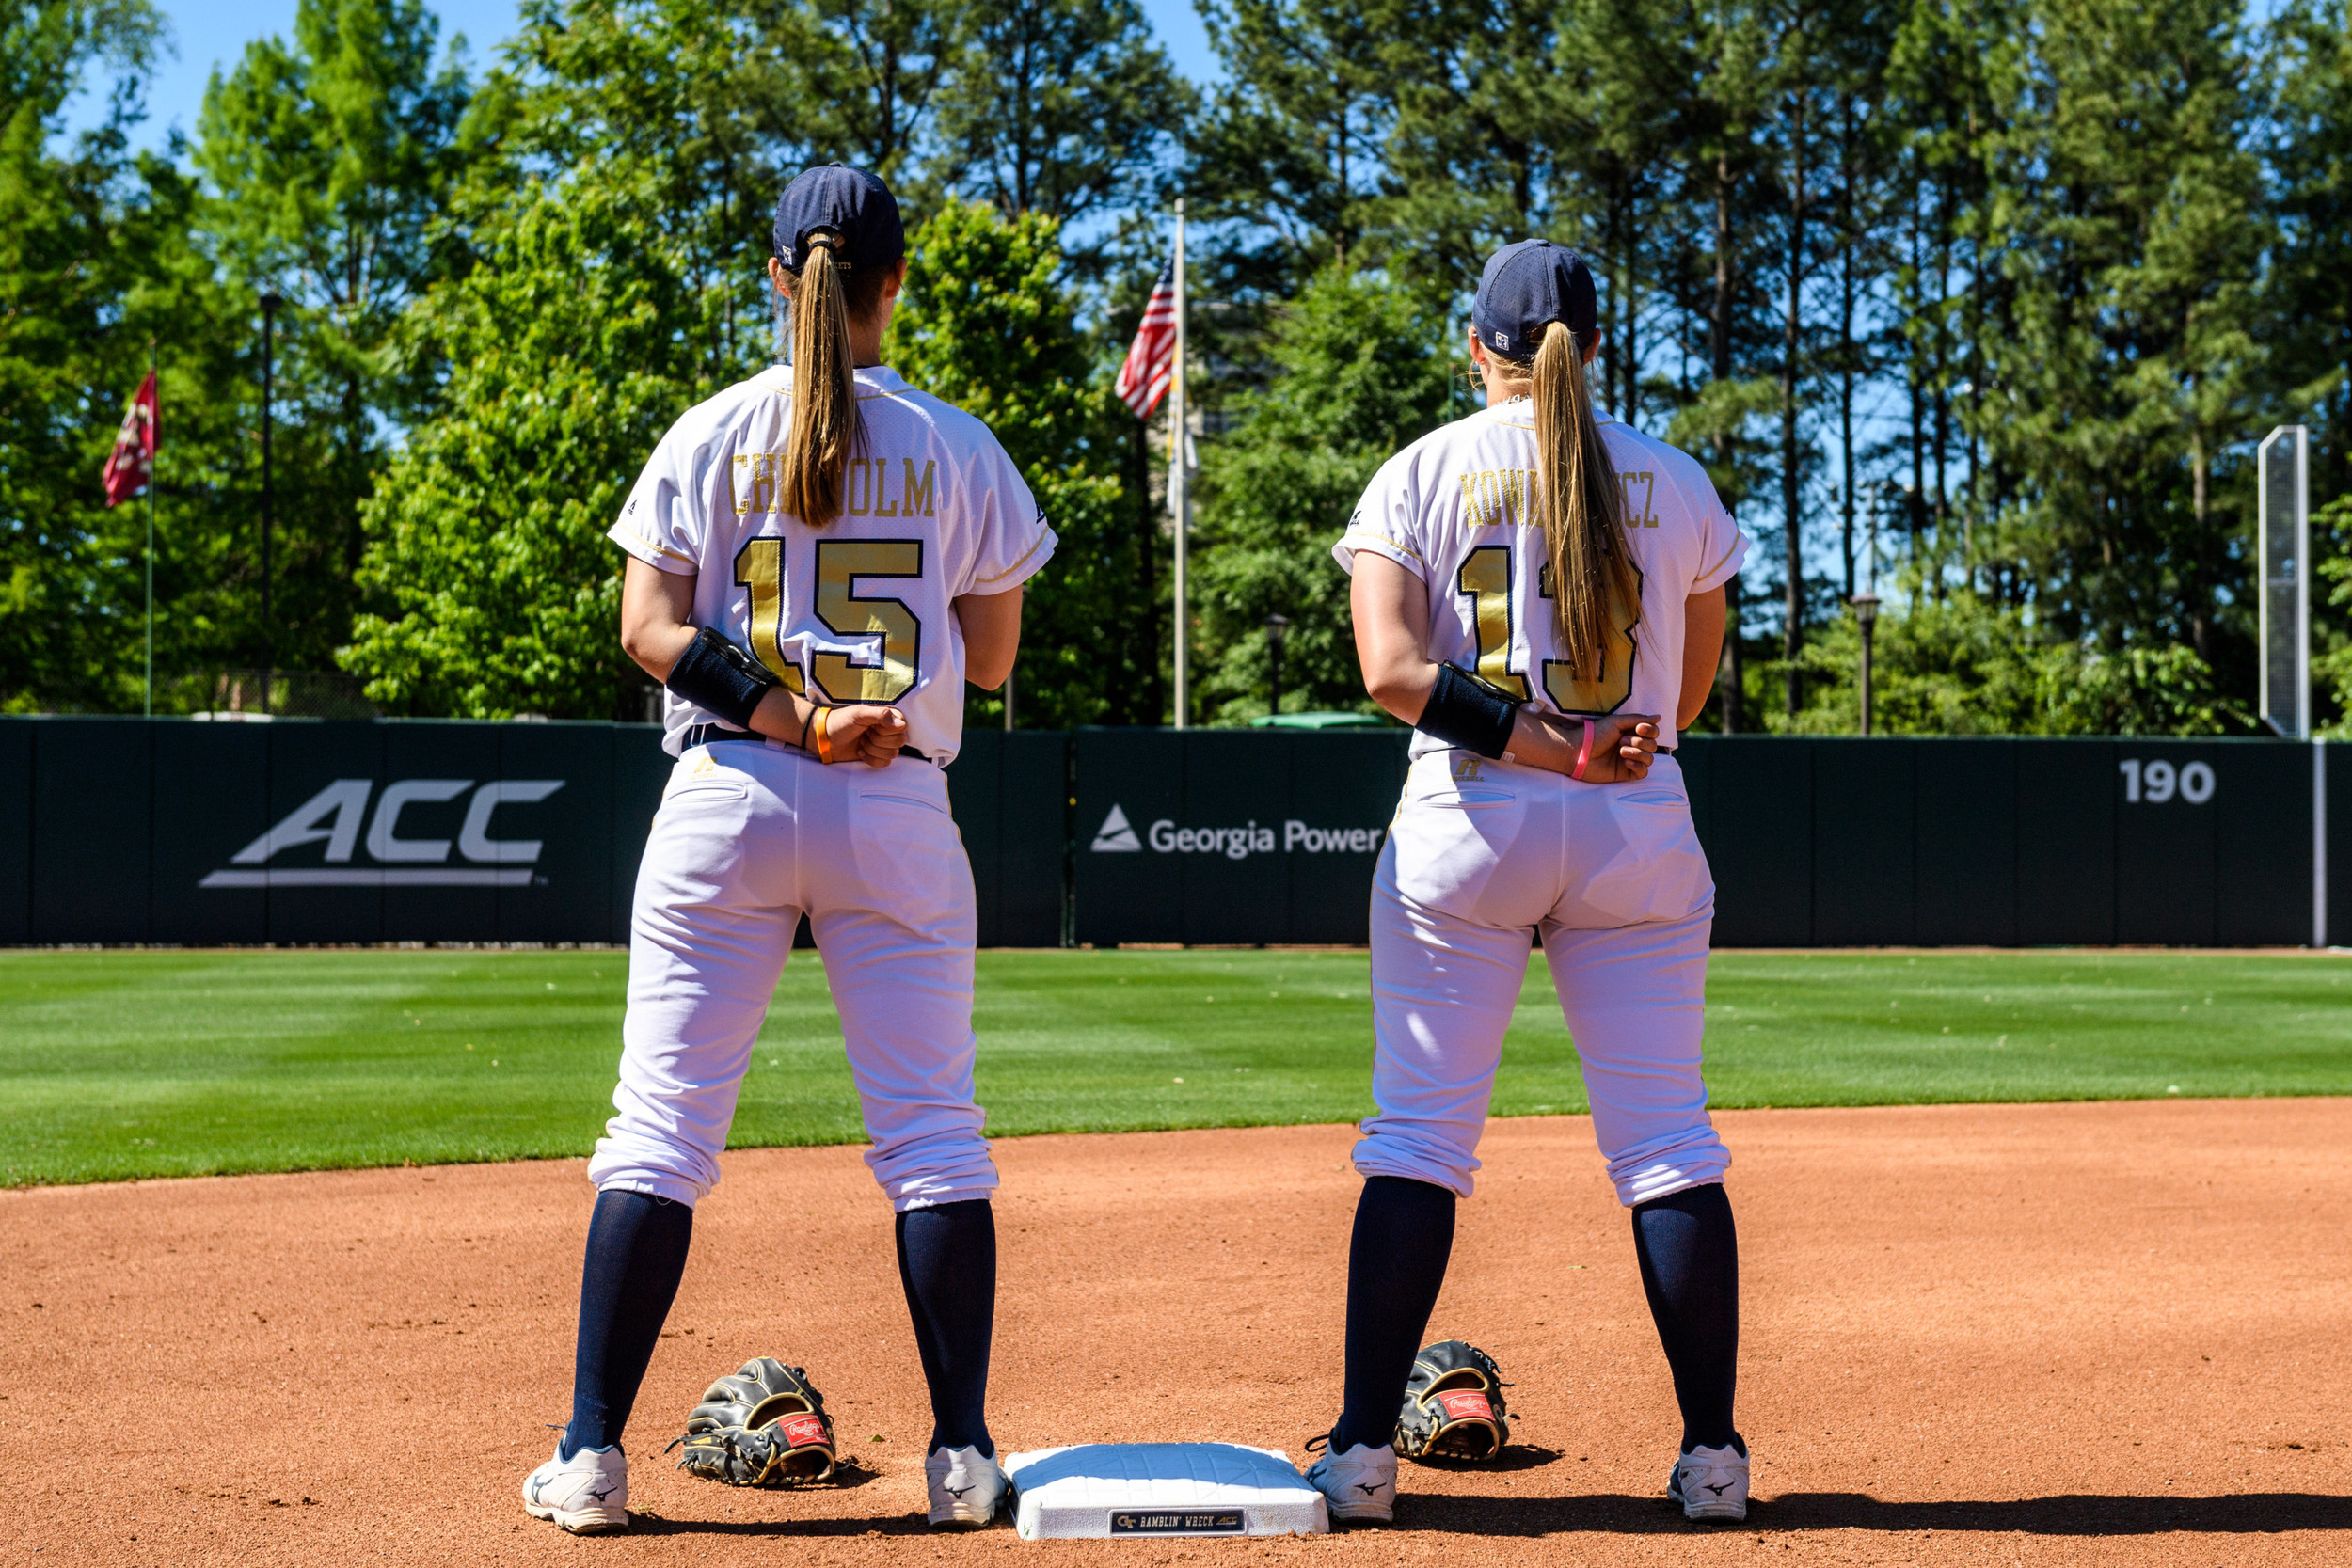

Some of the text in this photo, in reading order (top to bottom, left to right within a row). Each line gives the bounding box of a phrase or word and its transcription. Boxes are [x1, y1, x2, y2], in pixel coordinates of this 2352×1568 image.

[734, 537, 923, 705] 15
[2119, 759, 2215, 803] 190
[230, 779, 566, 863] ACC
[1149, 819, 1383, 859] Georgia Power
[1139, 1516, 1182, 1528] RAMBLIN'
[1185, 1516, 1215, 1527] WRECK
